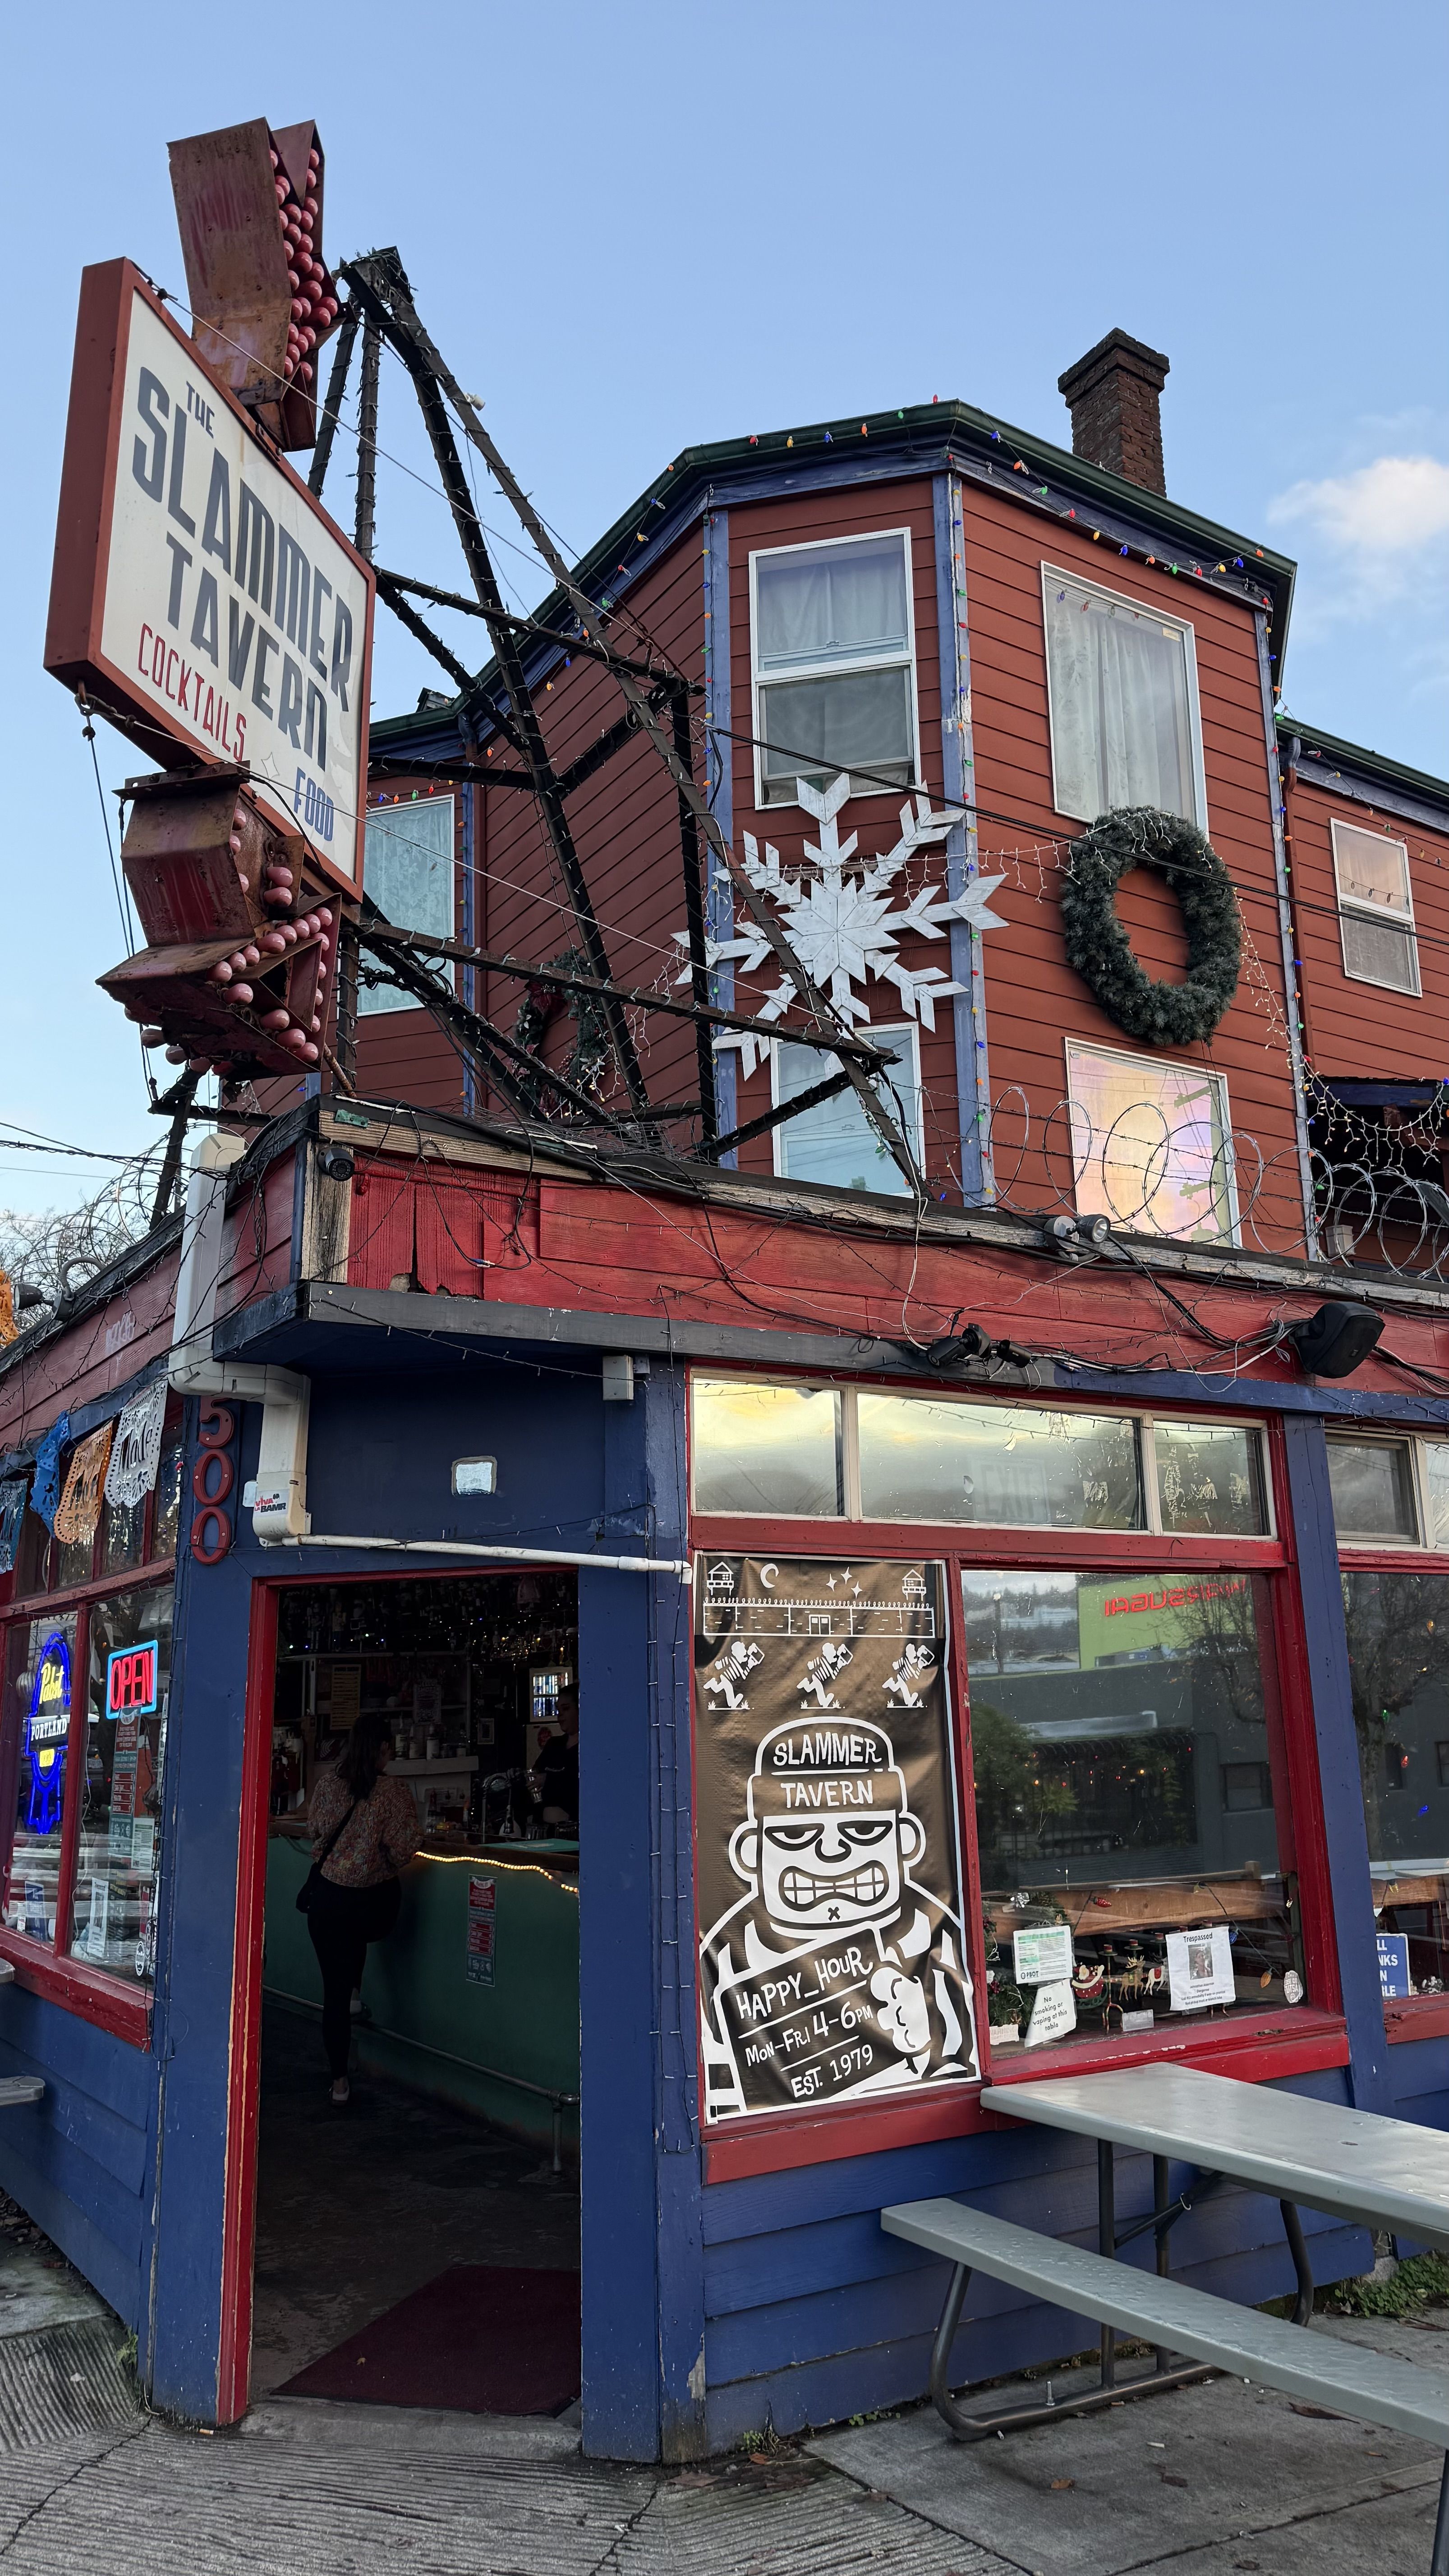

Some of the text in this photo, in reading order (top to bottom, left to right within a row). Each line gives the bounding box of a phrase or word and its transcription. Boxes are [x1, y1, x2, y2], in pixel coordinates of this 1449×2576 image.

[186, 381, 215, 439] THE
[132, 366, 353, 713] SLAMMER
[166, 530, 327, 772] TAVERN
[138, 623, 247, 762] COCKTAILS
[294, 766, 334, 842] FOOD
[191, 1395, 234, 1565] 500
[255, 1495, 273, 1507] VIVA
[39, 1662, 64, 1704] Pabst
[110, 1650, 154, 1710] OPEN
[31, 1718, 67, 1741] PORTLAND
[773, 1732, 882, 1766] SLAMMER
[780, 1780, 873, 1808] TAVERN
[1183, 1932, 1213, 1943] Trespassed
[1377, 1940, 1387, 1950] LL
[814, 1946, 873, 1991] HOUR
[1378, 1954, 1398, 1966] NKS
[1380, 1970, 1387, 1982] N
[1381, 1985, 1396, 1997] BLE
[813, 2001, 874, 2037] 4-6PM
[1033, 2017, 1051, 2025] vaping
[1035, 2004, 1056, 2016] smoking
[1045, 2022, 1058, 2031] table
[791, 2044, 873, 2098] EST. 1979
